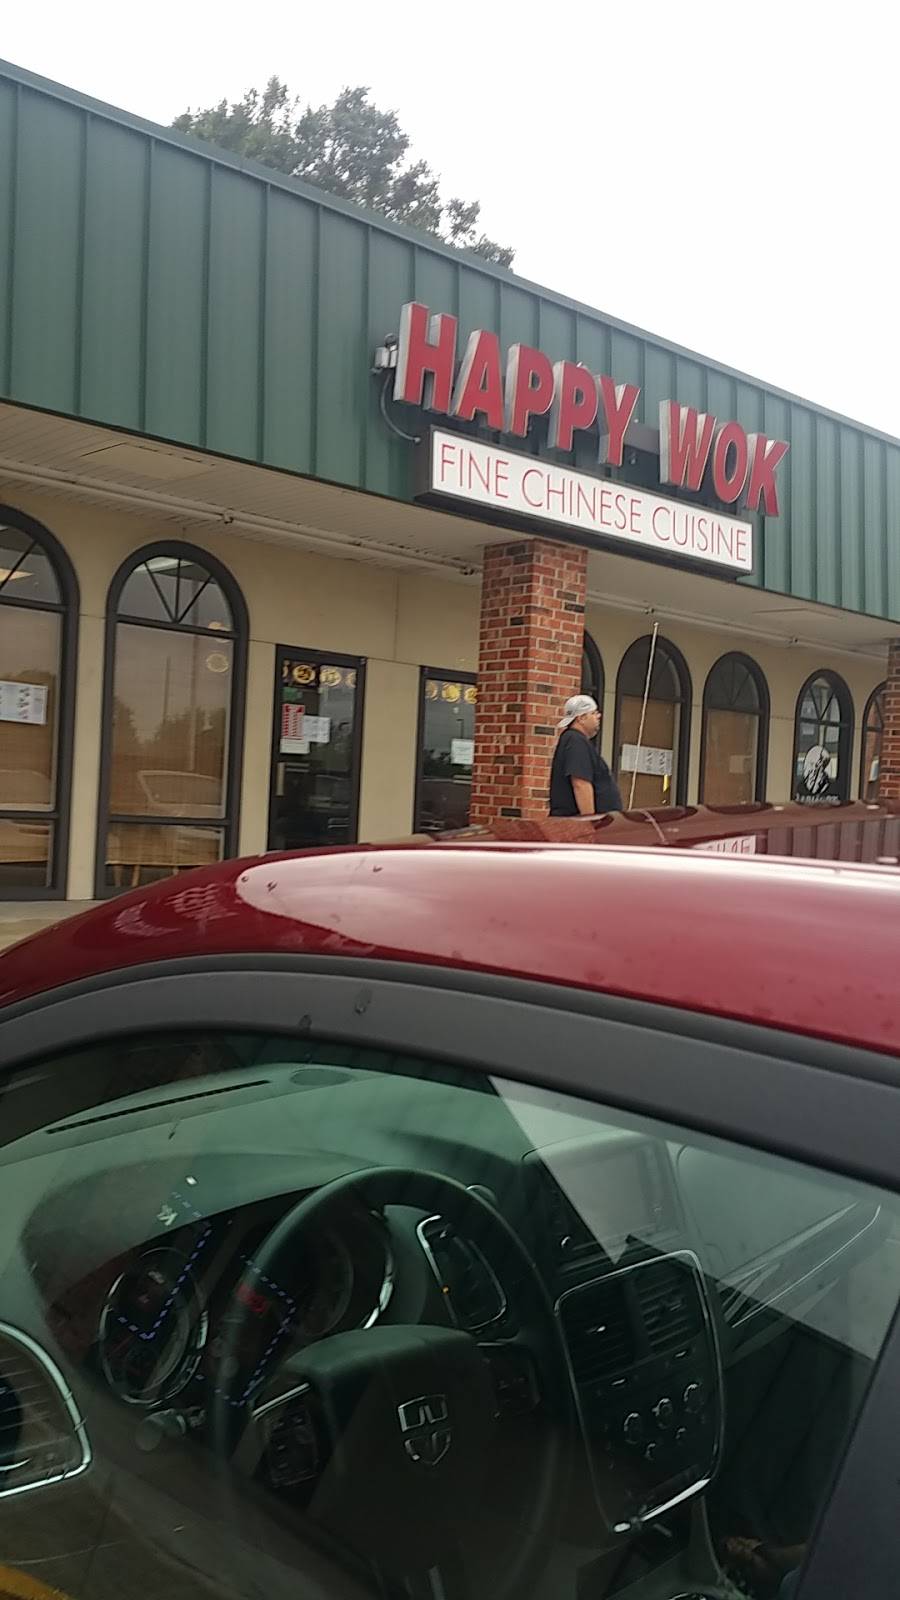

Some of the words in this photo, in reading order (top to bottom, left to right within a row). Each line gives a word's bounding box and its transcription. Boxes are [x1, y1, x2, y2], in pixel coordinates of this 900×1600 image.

[395, 302, 640, 467] HAPPY
[660, 400, 789, 517] WOK
[440, 443, 509, 499] FINE
[521, 468, 643, 534] CHINESE
[652, 506, 748, 562] CUISINE
